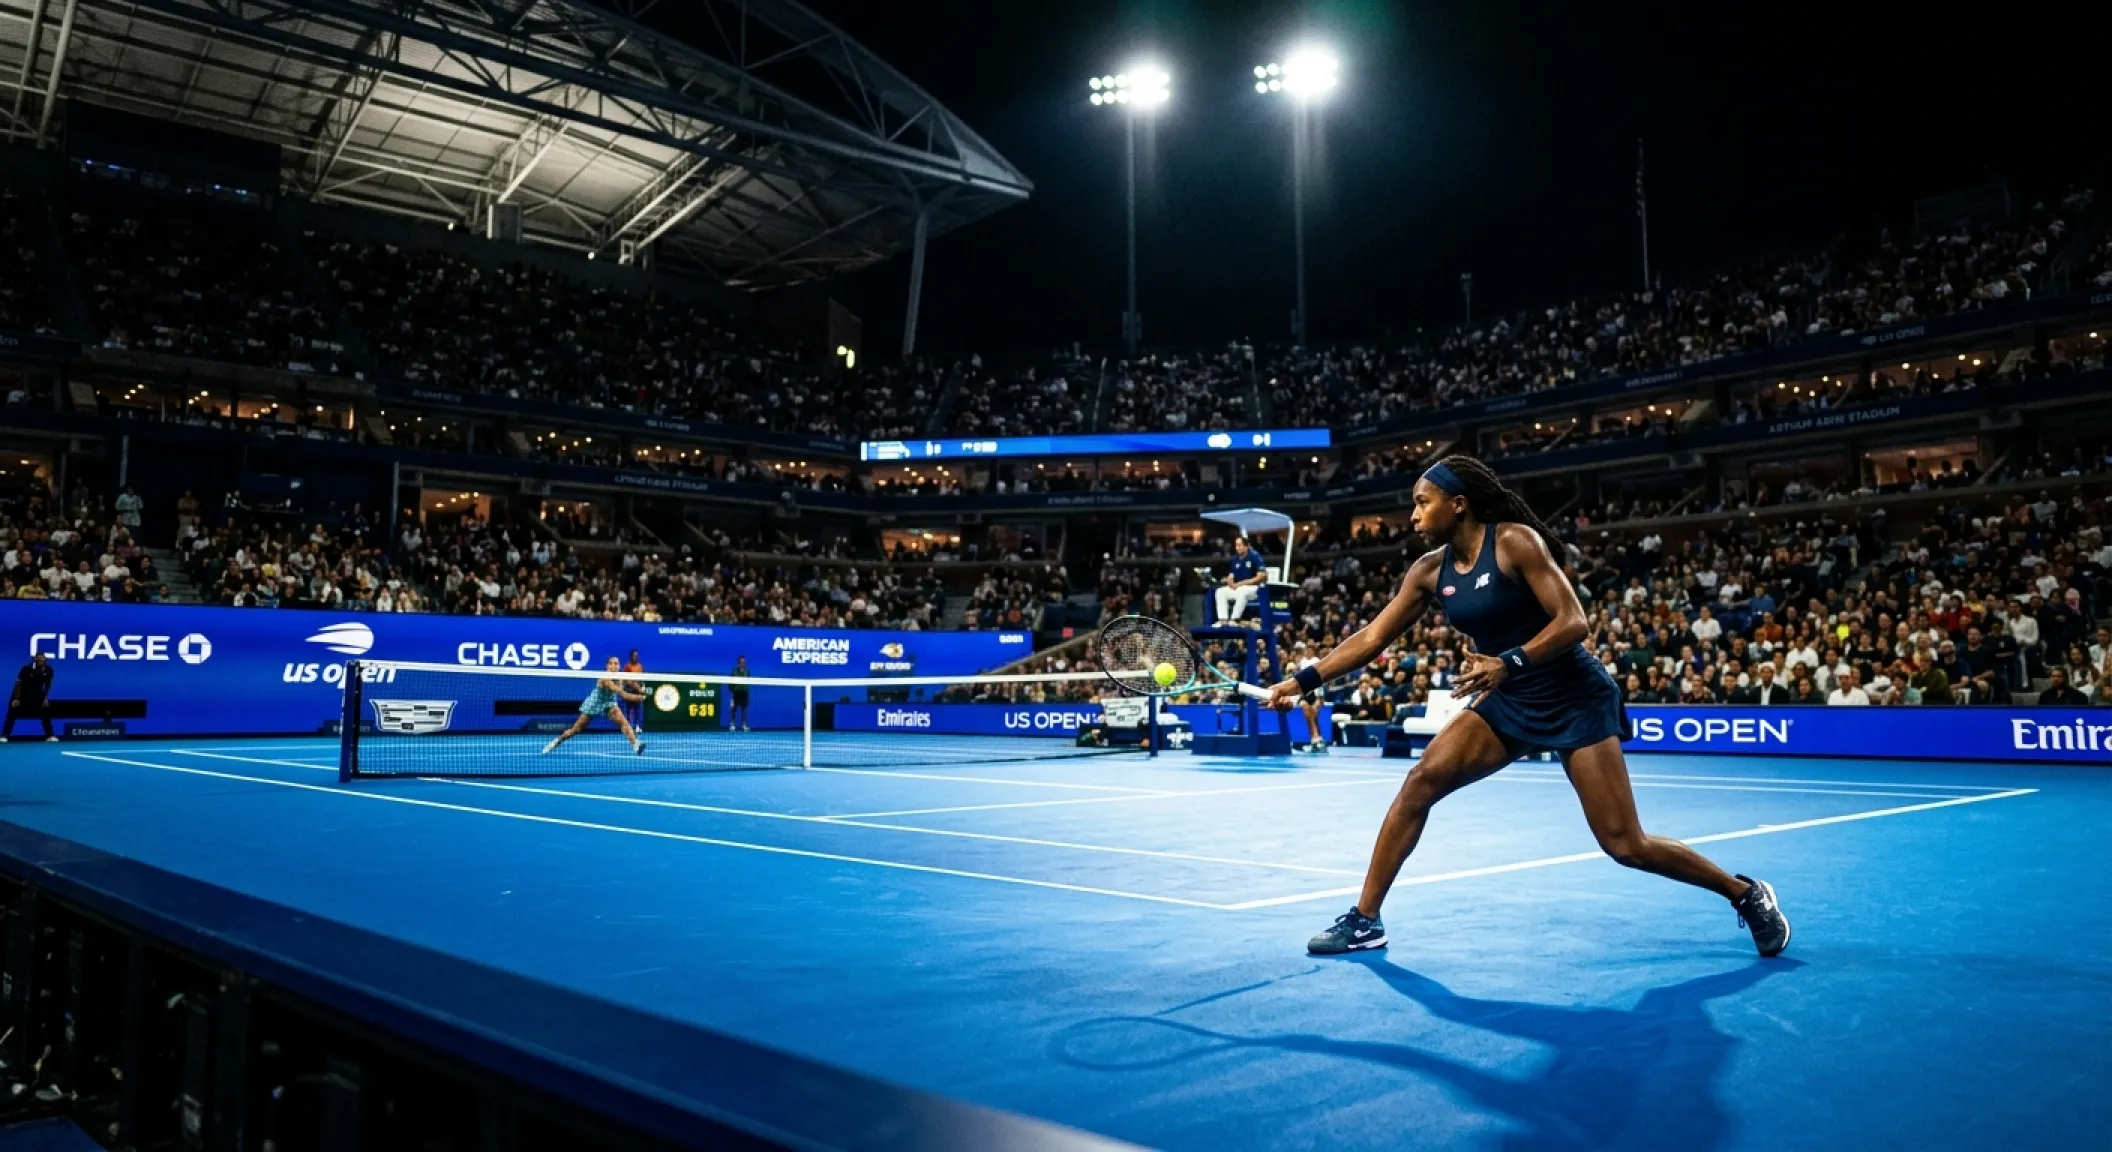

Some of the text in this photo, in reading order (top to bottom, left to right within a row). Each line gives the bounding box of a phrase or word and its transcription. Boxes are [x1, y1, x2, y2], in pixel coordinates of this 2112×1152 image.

[29, 632, 171, 661] CHASE
[772, 637, 850, 652] AMERICAN
[457, 642, 560, 667] CHASE
[781, 650, 849, 665] EXPRESS
[283, 663, 320, 683] us
[877, 709, 931, 728] Emirates
[1004, 712, 1091, 730] US OPEN
